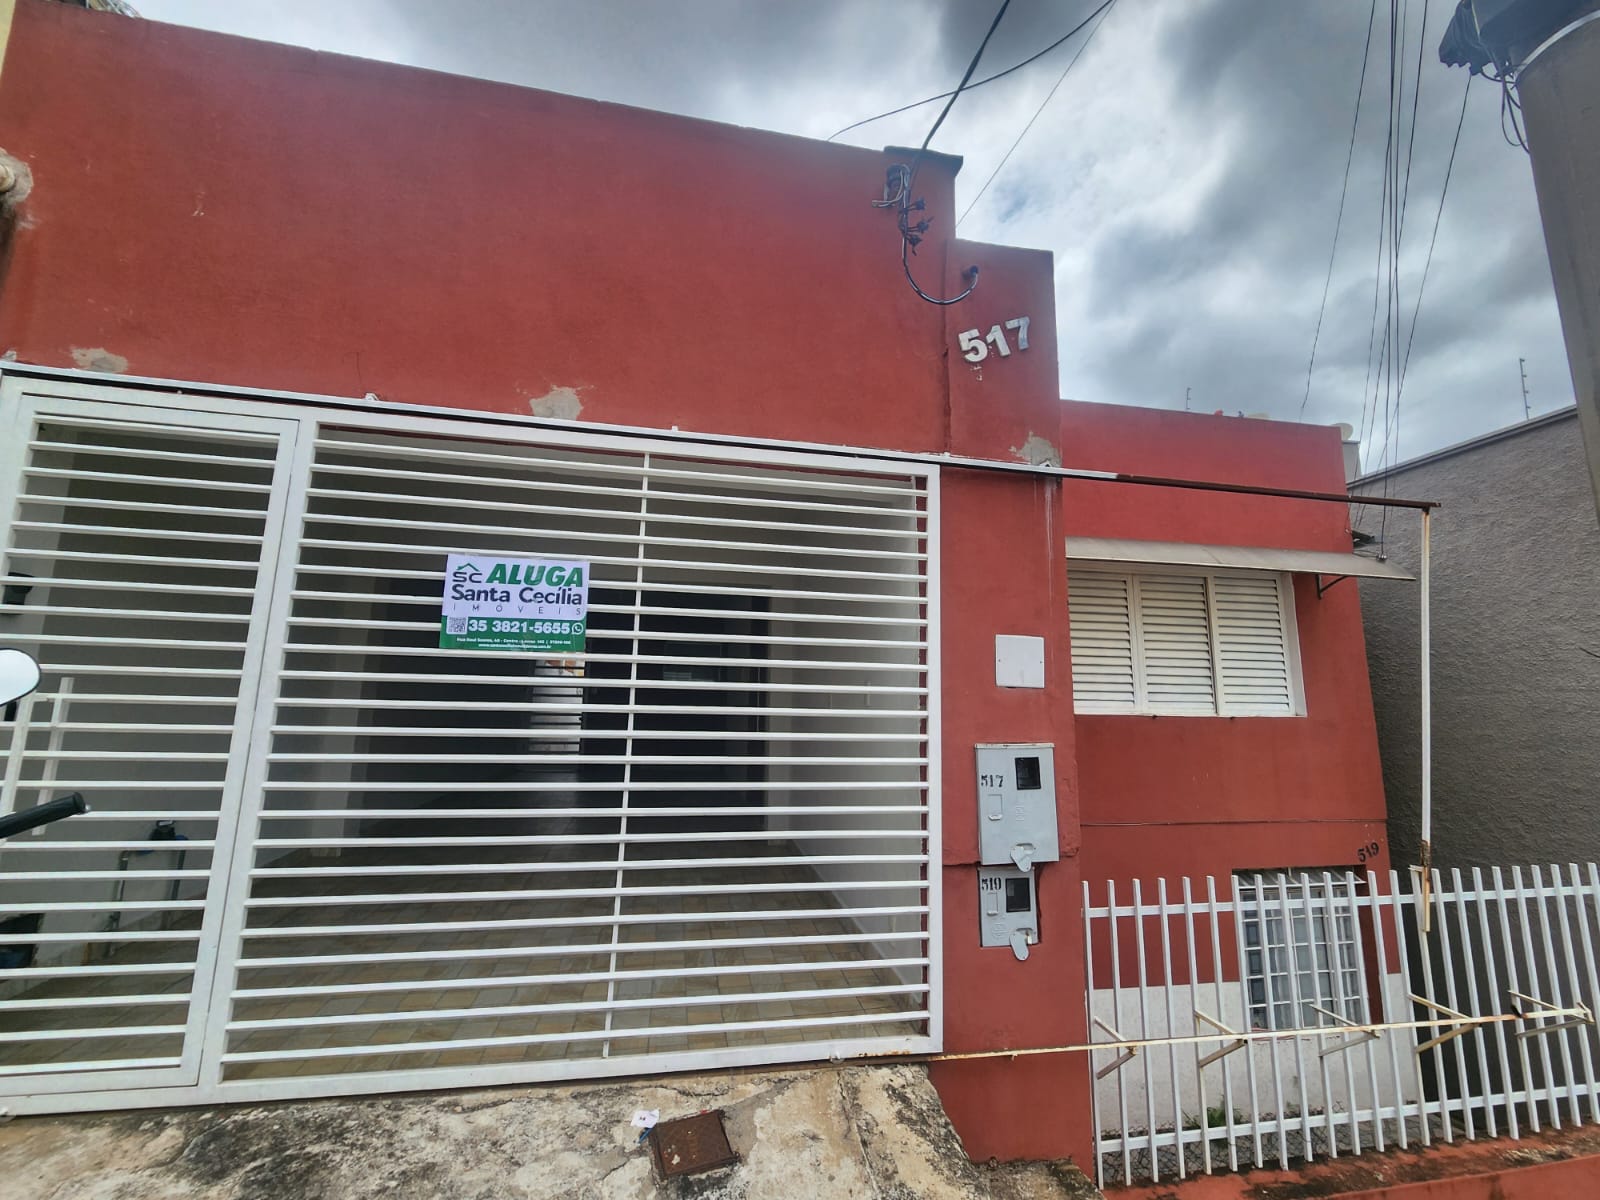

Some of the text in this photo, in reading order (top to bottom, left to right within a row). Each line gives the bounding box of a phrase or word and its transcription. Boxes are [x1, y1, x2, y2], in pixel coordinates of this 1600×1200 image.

[958, 316, 1030, 362] 517
[486, 563, 583, 588] ALUGA
[451, 583, 582, 606] Santa Cecília
[468, 619, 570, 634] 35 3821-5655
[981, 774, 1004, 788] 517
[1357, 842, 1379, 862] 519
